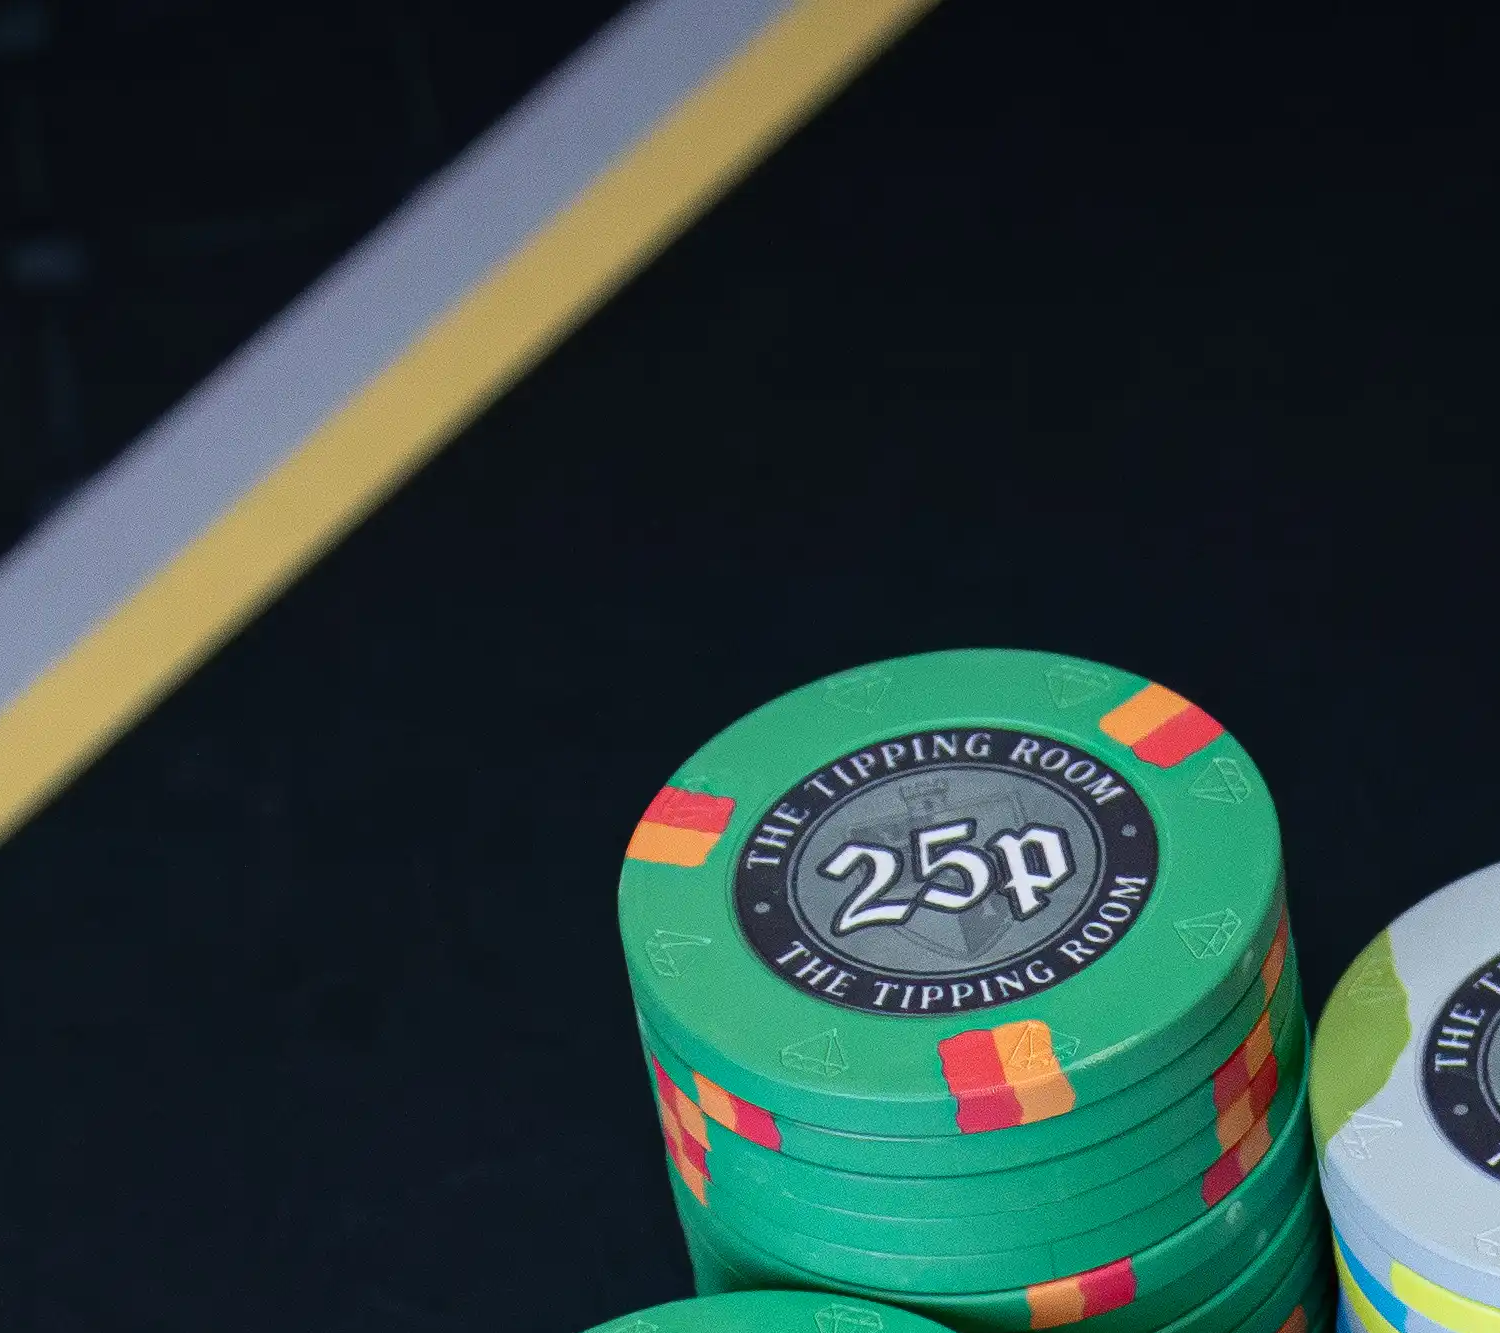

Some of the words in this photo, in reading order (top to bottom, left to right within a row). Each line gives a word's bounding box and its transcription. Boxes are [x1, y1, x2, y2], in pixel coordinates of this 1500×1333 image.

[746, 806, 809, 869] THE
[803, 733, 991, 799] TIPPING
[1010, 738, 1127, 806] ROOM
[818, 819, 1076, 936] 25p
[775, 940, 858, 998] THE
[872, 960, 1056, 1011] TIPPING
[1059, 874, 1149, 964] ROOM
[1435, 1003, 1487, 1069] THE
